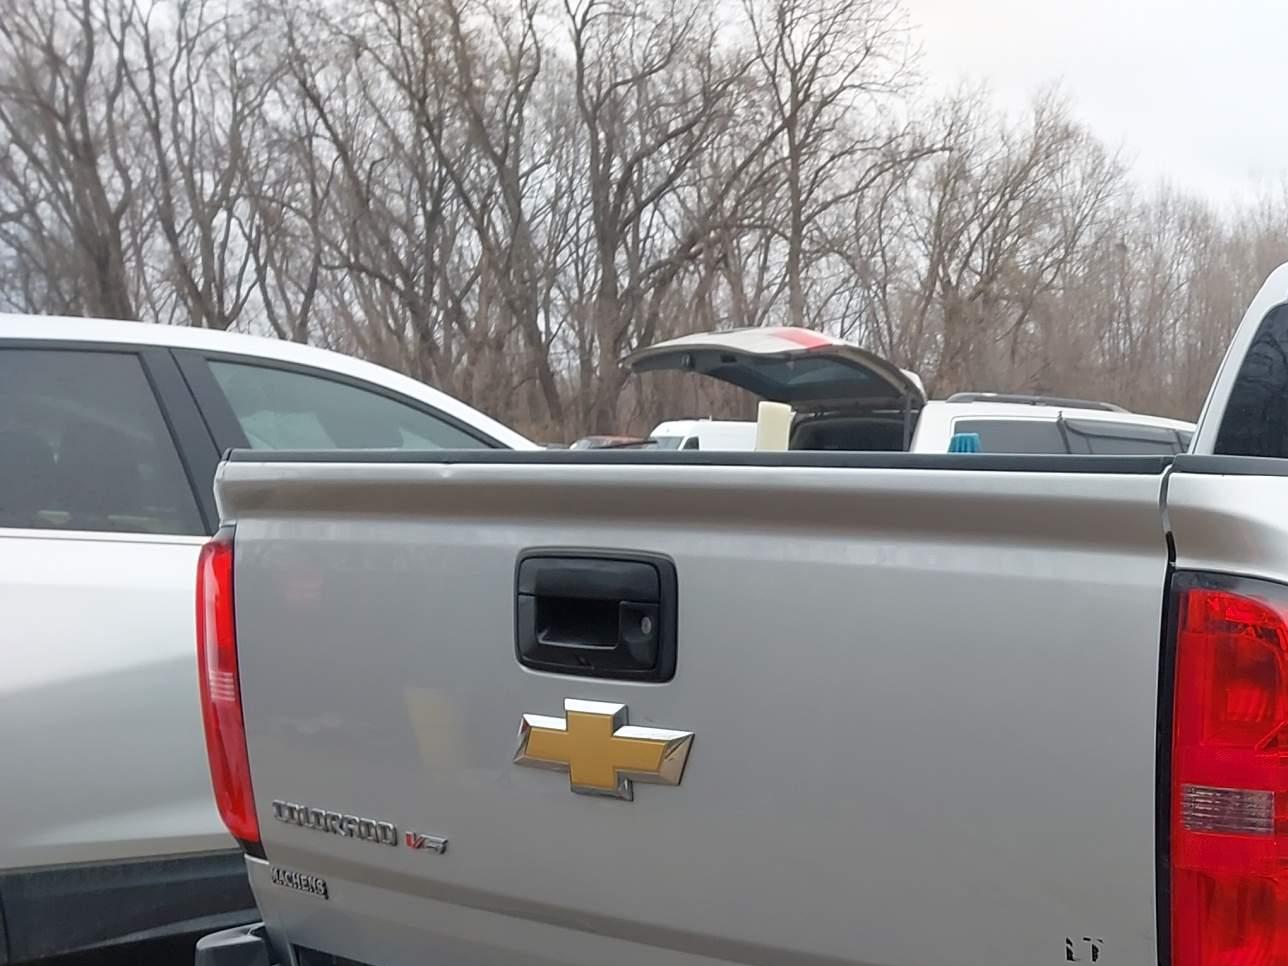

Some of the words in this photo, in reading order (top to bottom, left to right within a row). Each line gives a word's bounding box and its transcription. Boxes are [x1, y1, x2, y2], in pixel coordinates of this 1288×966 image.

[272, 799, 399, 847] COLORADO
[270, 867, 329, 900] MACHENS
[1065, 936, 1104, 962] LT
